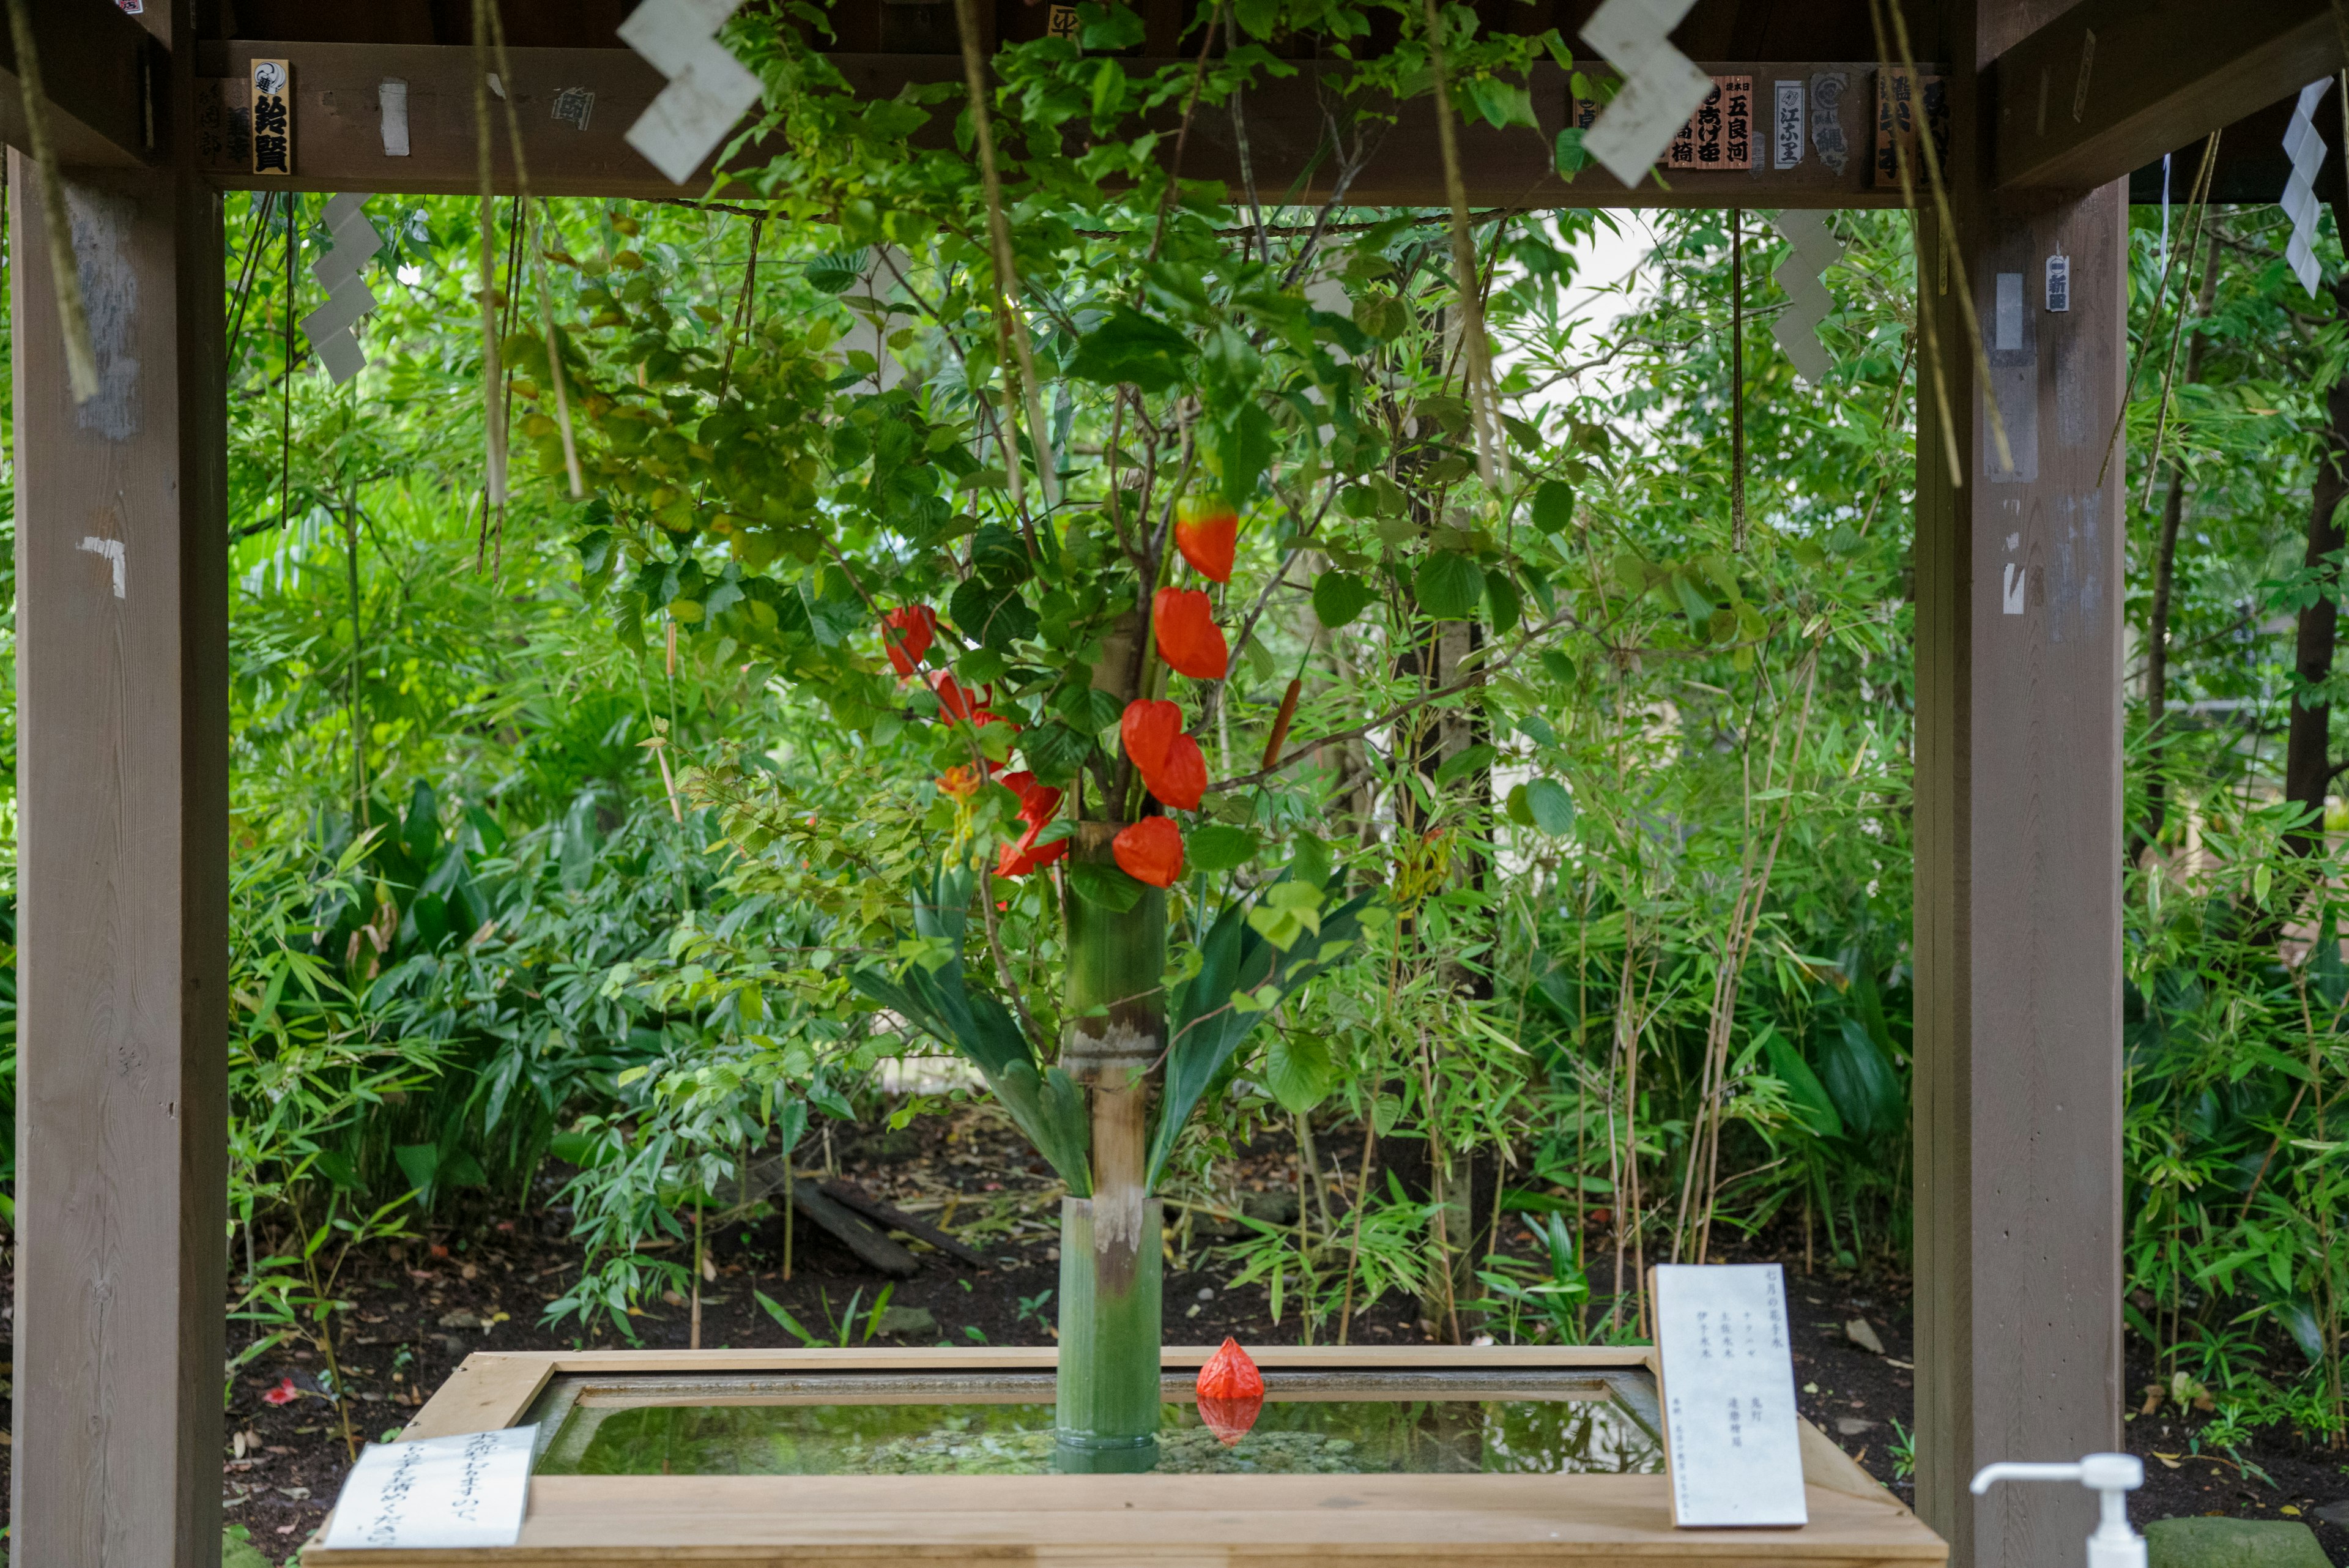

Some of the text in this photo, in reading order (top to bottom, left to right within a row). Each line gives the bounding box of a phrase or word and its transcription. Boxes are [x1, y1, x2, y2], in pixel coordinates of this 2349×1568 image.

[254, 95, 287, 173] 鈴賢
[1726, 95, 1749, 162] 五良河
[2049, 273, 2066, 309] 新田
